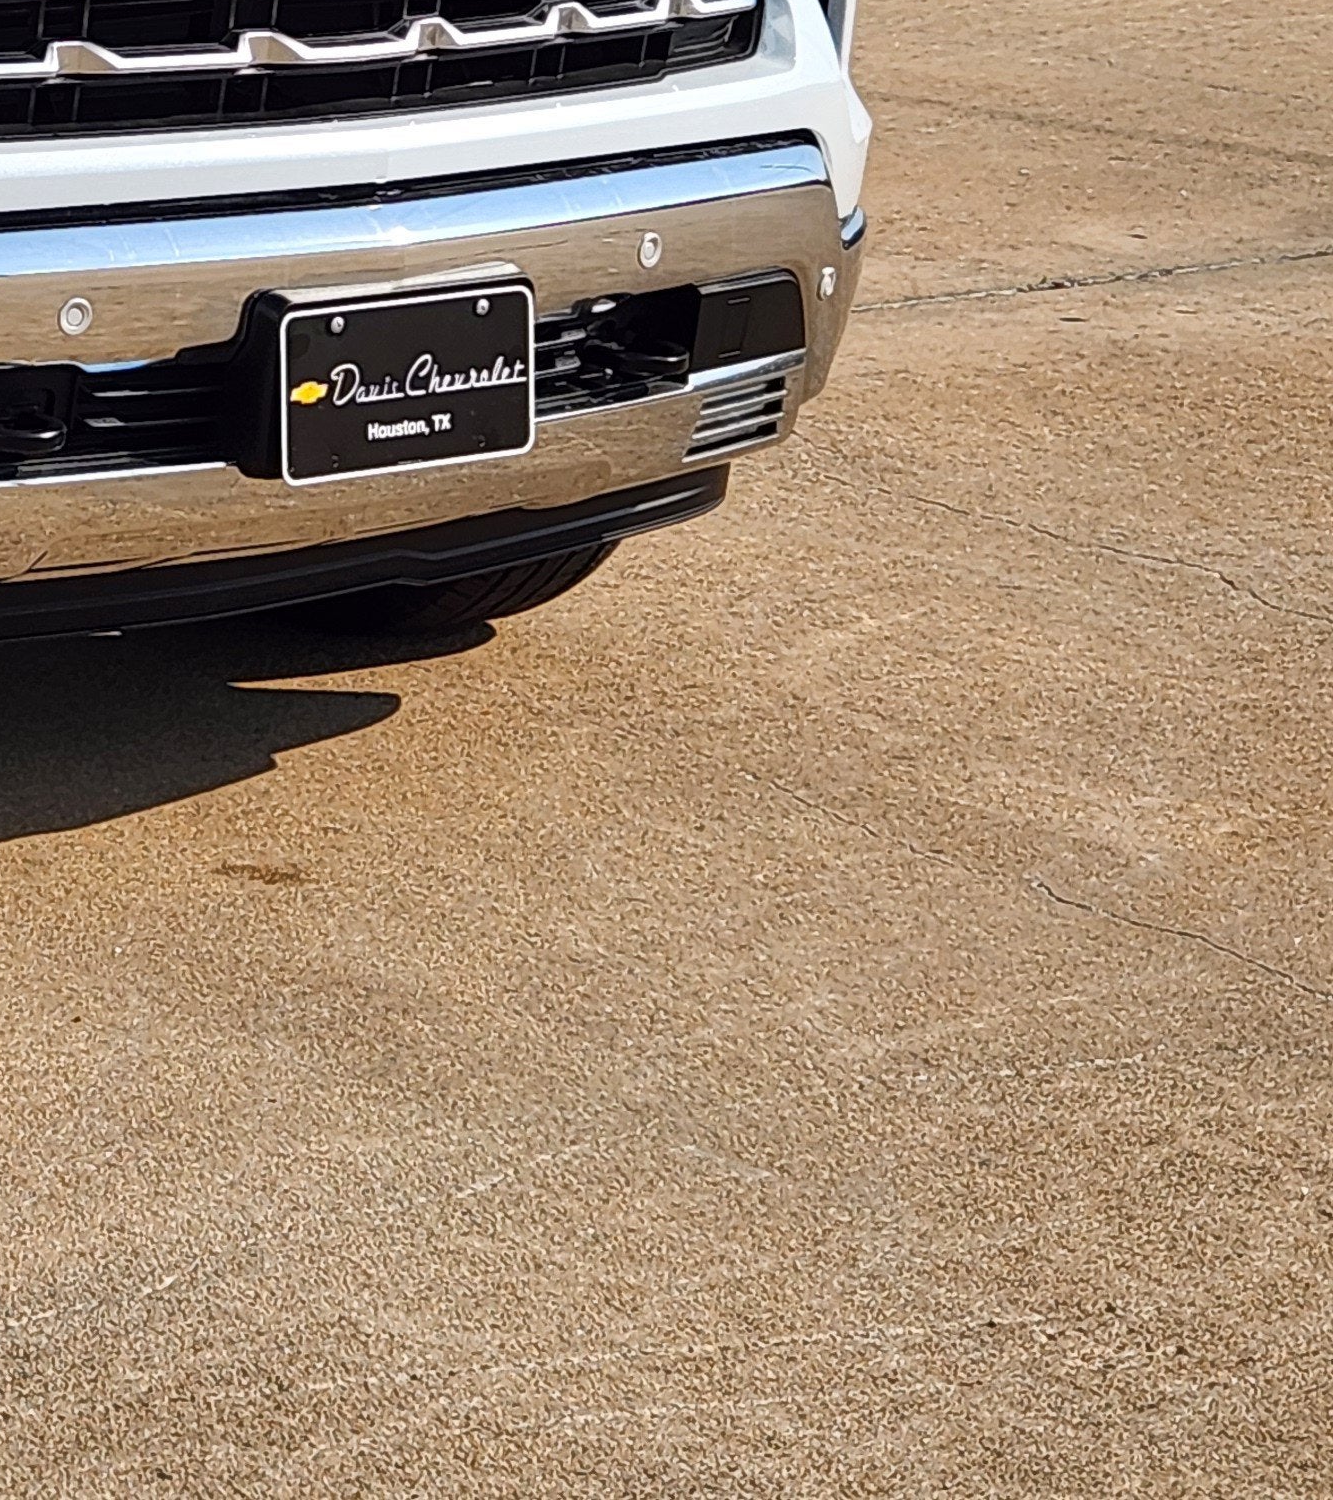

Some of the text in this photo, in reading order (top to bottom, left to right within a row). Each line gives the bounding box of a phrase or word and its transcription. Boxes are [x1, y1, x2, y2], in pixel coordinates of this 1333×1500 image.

[330, 353, 527, 406] Davis Chevrolet
[367, 412, 452, 441] Houston, TX
